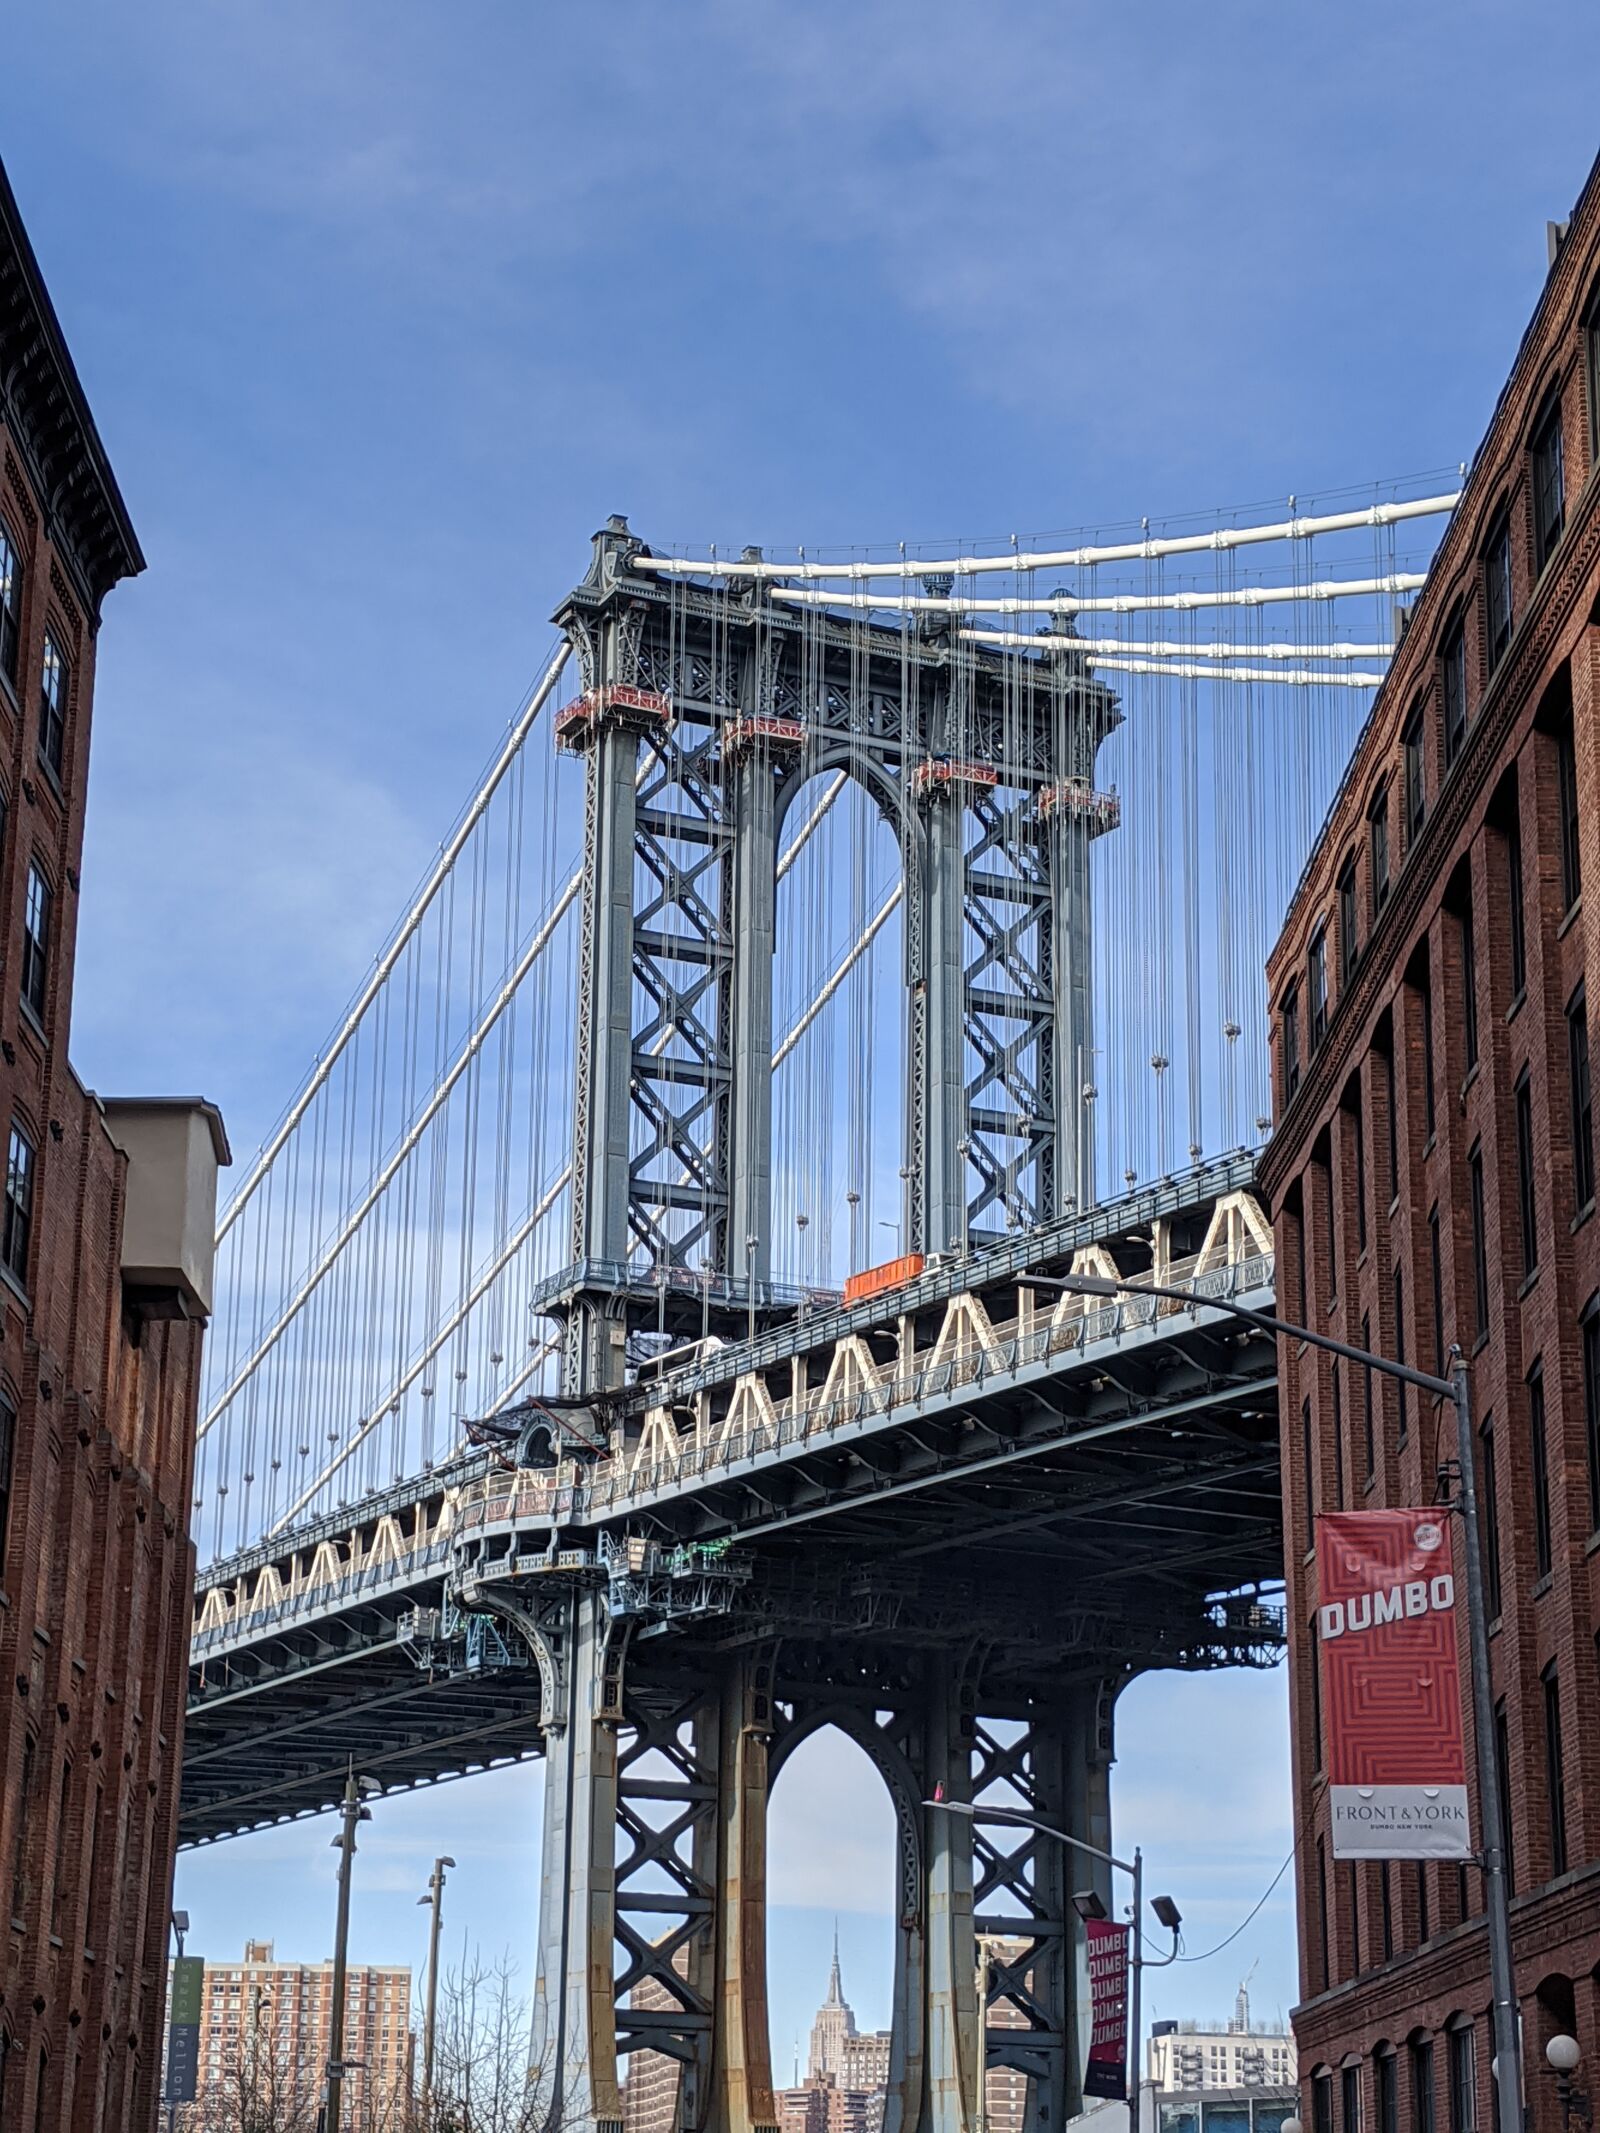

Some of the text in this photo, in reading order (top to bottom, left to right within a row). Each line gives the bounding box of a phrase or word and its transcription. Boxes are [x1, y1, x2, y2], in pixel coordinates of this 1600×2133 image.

[1320, 1574, 1455, 1640] DUMBO
[173, 1963, 192, 2096] Smack Mellon
